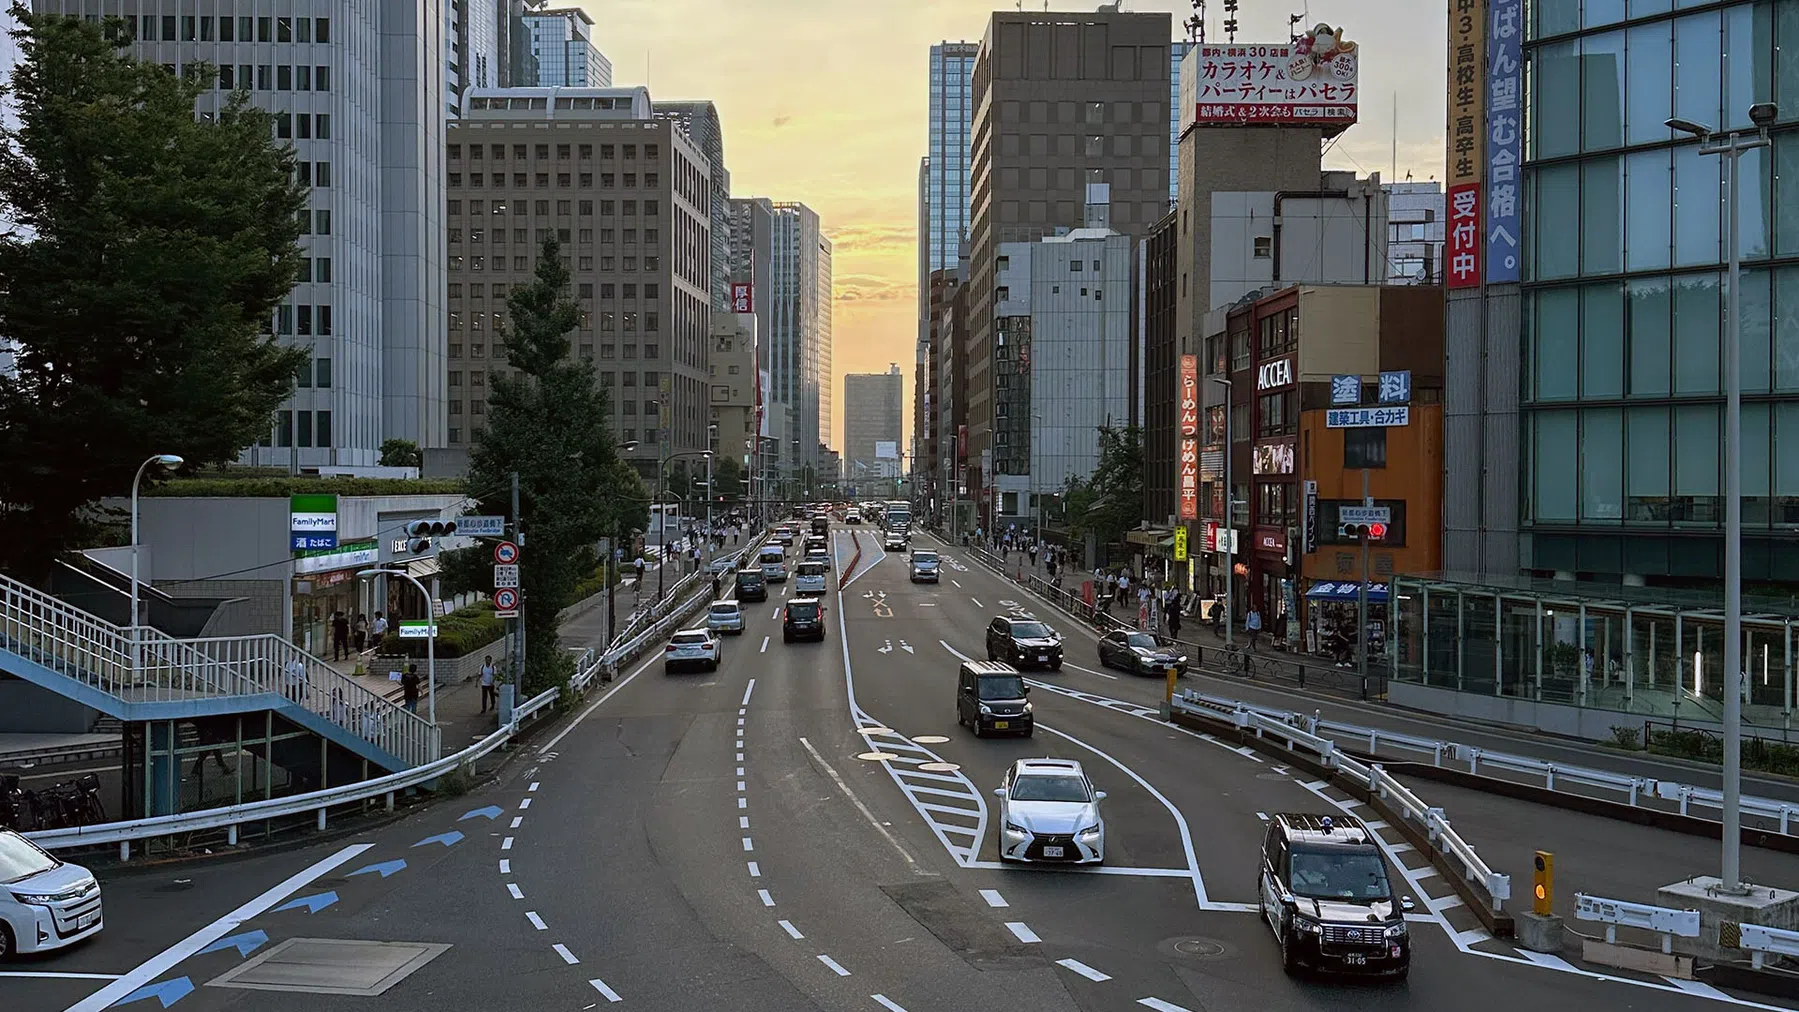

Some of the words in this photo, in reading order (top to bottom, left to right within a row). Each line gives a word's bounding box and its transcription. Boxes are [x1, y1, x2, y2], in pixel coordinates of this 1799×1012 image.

[1201, 82, 1356, 101] パーティーはパセラ
[1490, 0, 1519, 270] ばん望む合格へ。
[1452, 189, 1476, 280] 受付中
[1257, 358, 1293, 391] ACCEA
[1328, 409, 1406, 426] 建築工具・合カギ
[292, 518, 335, 527] FamilyMart
[309, 539, 332, 547] たばこ
[400, 628, 437, 636] FamilyMt
